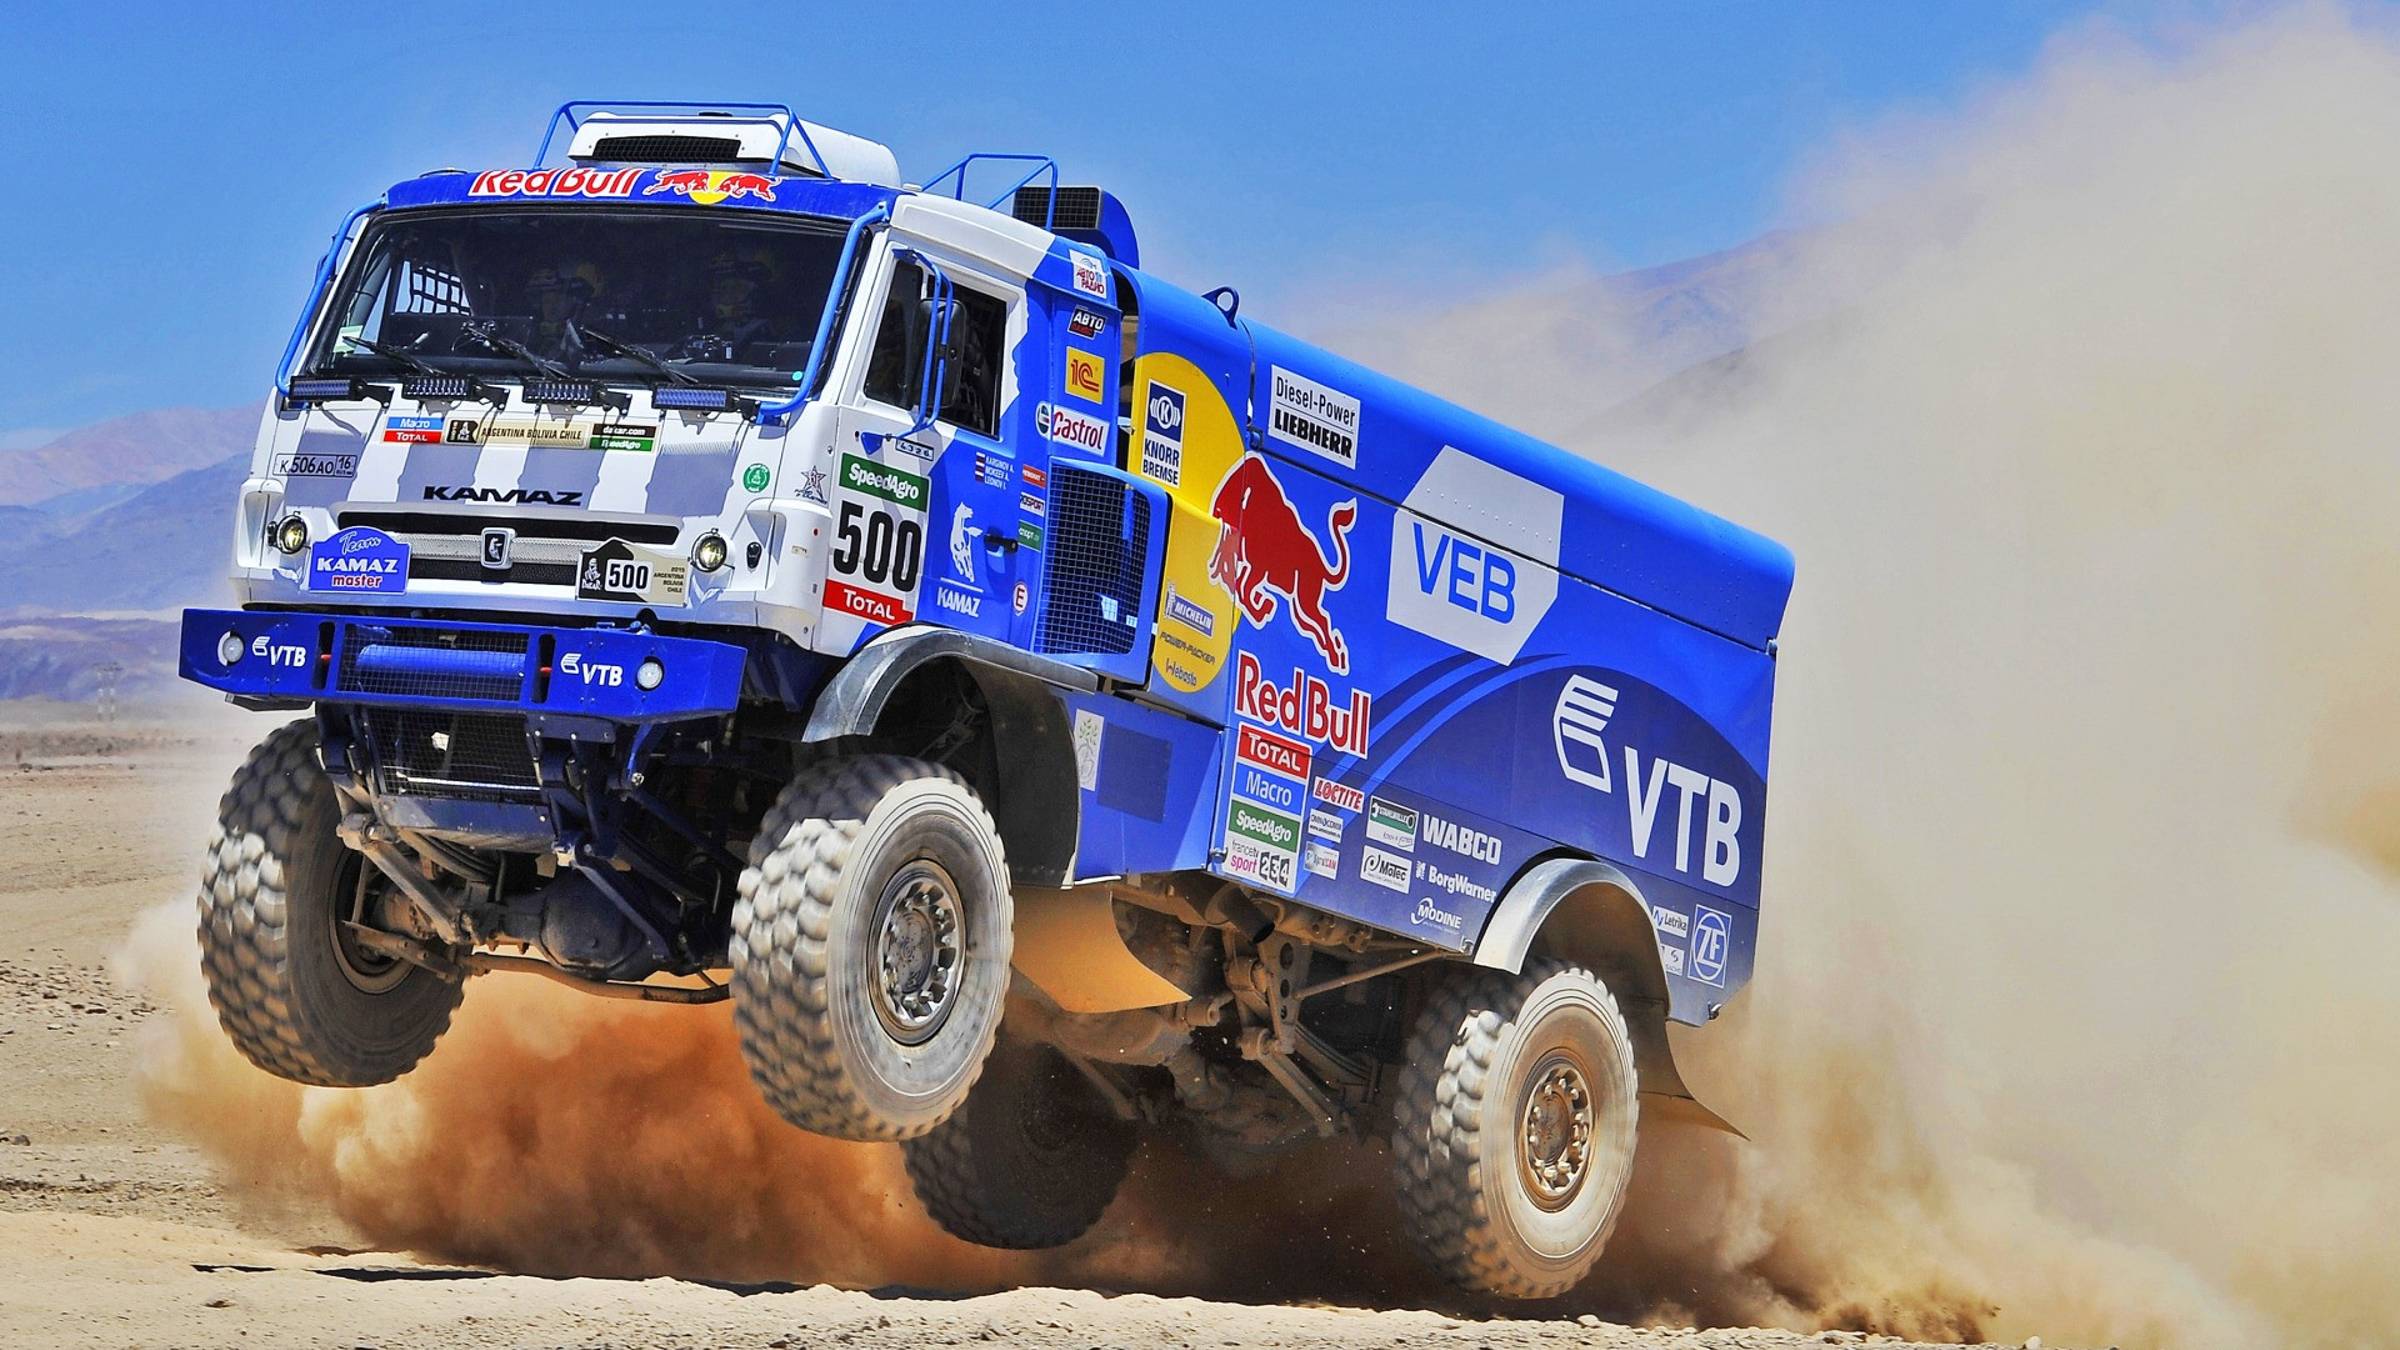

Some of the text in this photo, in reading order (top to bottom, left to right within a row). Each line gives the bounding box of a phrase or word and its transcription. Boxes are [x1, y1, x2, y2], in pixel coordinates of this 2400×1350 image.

[471, 168, 642, 194] Red Bull
[1276, 375, 1356, 427] Diesel-Power
[395, 431, 428, 441] TOTAL
[399, 418, 431, 429] Macro
[559, 430, 583, 440] CHILE
[1052, 410, 1105, 451] Castrol
[1274, 408, 1353, 459] LIEBHERR
[338, 456, 352, 470] 16
[1144, 438, 1180, 468] KNORR
[849, 462, 920, 500] SpeedAgro
[1143, 459, 1179, 486] BREMSE
[423, 485, 583, 507] KAMAZ
[340, 531, 382, 555] Team
[833, 500, 922, 592] 500
[316, 557, 400, 573] KAMAZ
[332, 574, 383, 587] master
[608, 563, 649, 590] 500
[1412, 522, 1517, 625] VEB
[843, 588, 896, 620] TOTAL
[936, 586, 981, 618] KAMAZ
[1174, 601, 1212, 630] MICHELIN
[270, 645, 307, 667] VTB
[582, 663, 624, 687] VTB
[1236, 653, 1370, 757] Red Bull
[1248, 733, 1302, 772] TOTAL
[1245, 770, 1292, 807] Macro
[1314, 779, 1364, 811] LOCTITE
[1235, 809, 1292, 842] SpeedAgro
[1624, 745, 1742, 888] VTB
[1423, 814, 1503, 866] WABCO
[1230, 854, 1257, 873] sport
[1428, 864, 1498, 904] BorgWarner
[1417, 903, 1463, 929] MODINE
[1695, 923, 1727, 969] ZF
